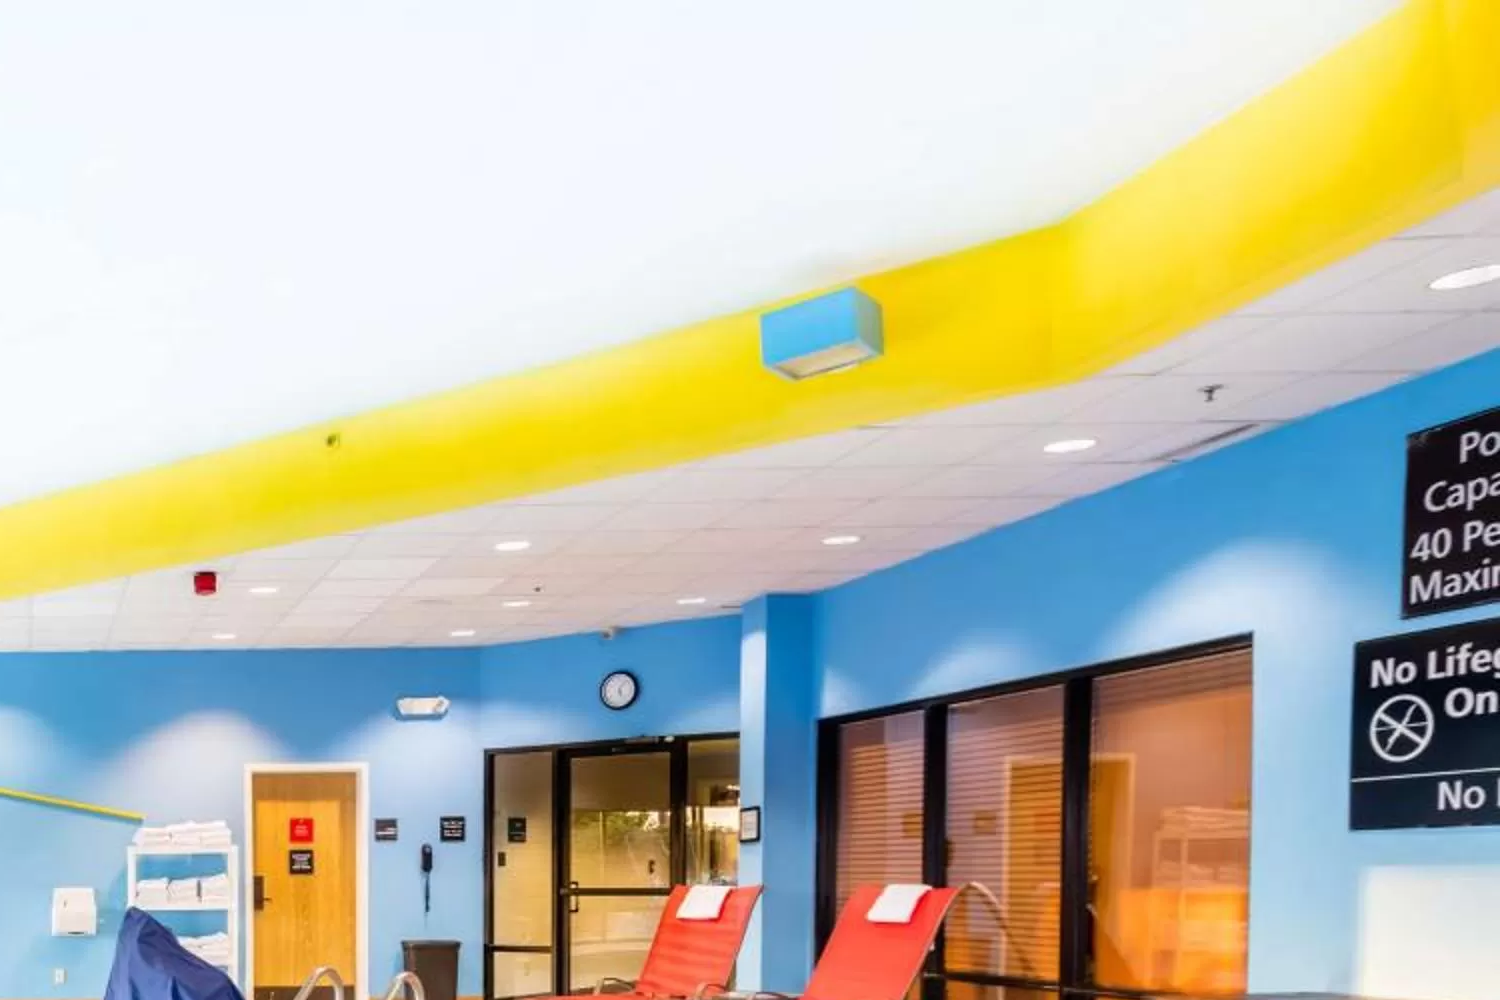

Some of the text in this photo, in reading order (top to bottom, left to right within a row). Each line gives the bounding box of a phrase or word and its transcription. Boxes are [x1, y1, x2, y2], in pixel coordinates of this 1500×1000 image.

[1410, 528, 1453, 561] 40
[1370, 657, 1418, 689] No
[1444, 687, 1498, 718] On
[1437, 780, 1487, 811] No
